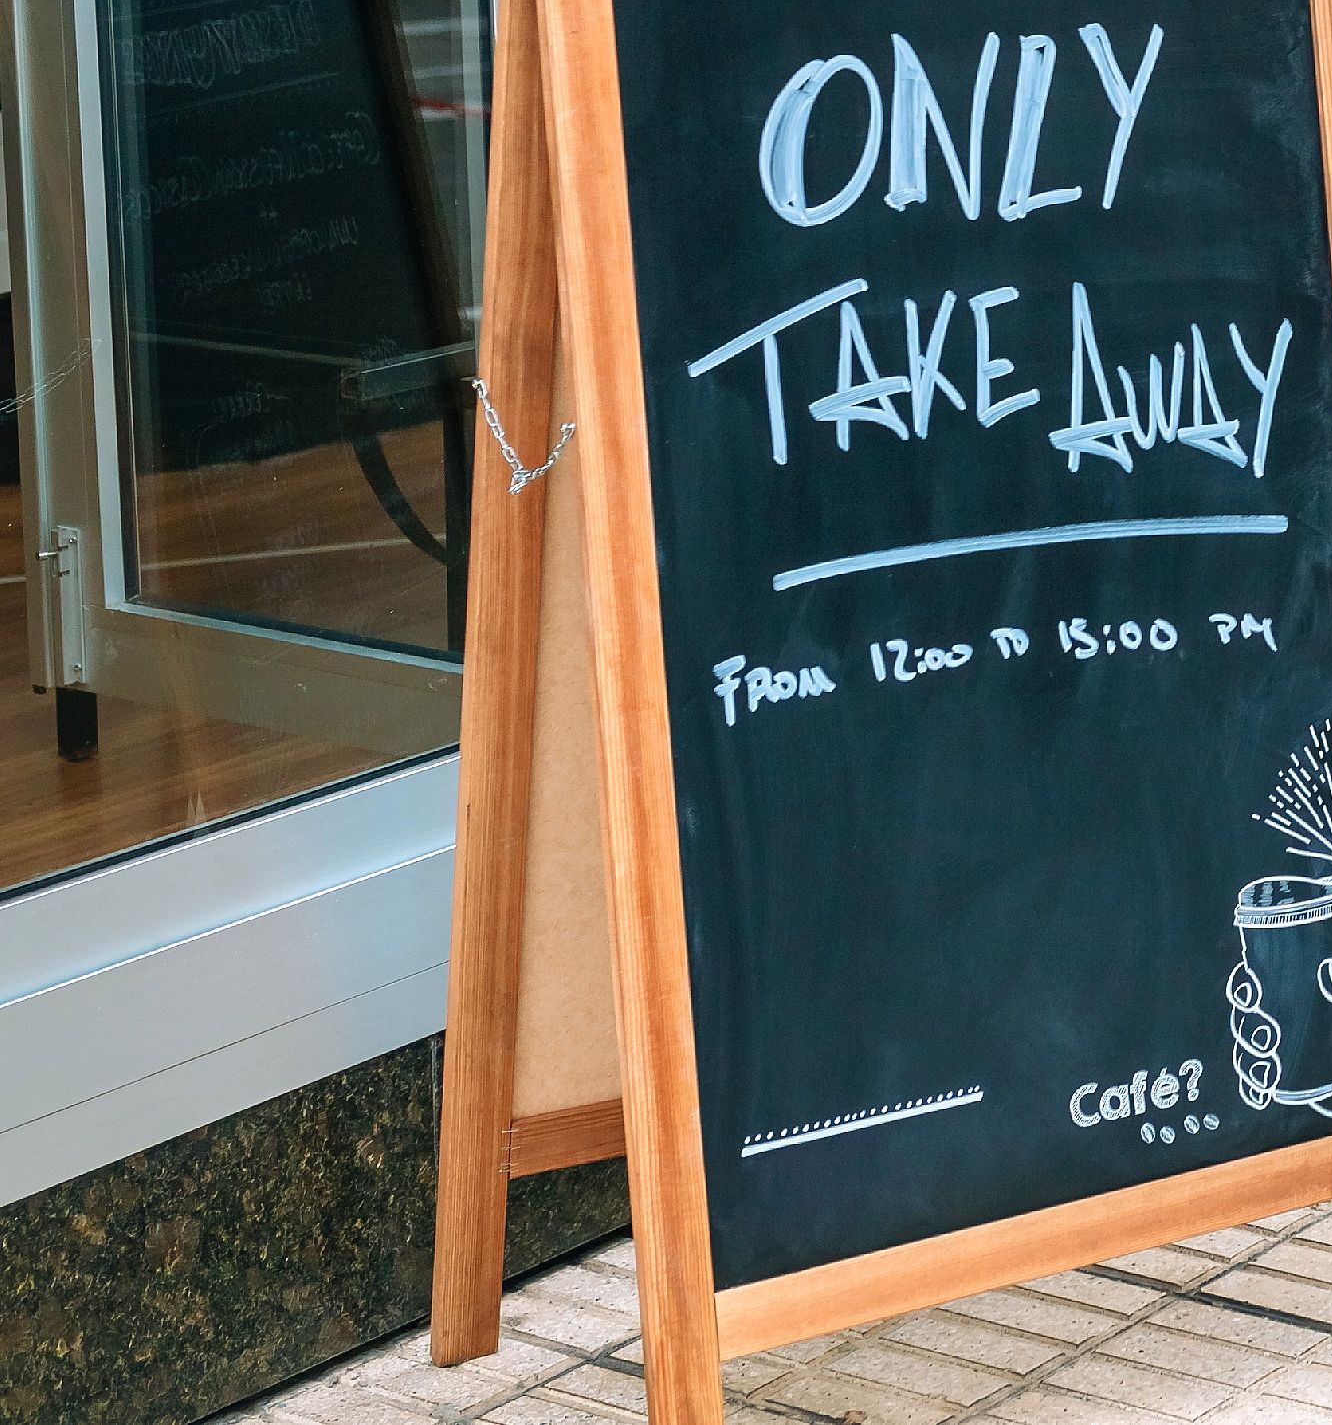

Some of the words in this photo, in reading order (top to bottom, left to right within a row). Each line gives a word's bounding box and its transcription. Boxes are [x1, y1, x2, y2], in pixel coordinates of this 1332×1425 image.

[759, 23, 1164, 227] ONLY
[687, 279, 1040, 465] TAKE
[1050, 282, 1292, 477] AWAY
[714, 655, 836, 726] FROM
[870, 639, 973, 682] 12:00
[991, 627, 1029, 659] TO
[1058, 617, 1178, 659] 15:00
[1209, 612, 1278, 651] PM
[1069, 1059, 1203, 1127] Café?
